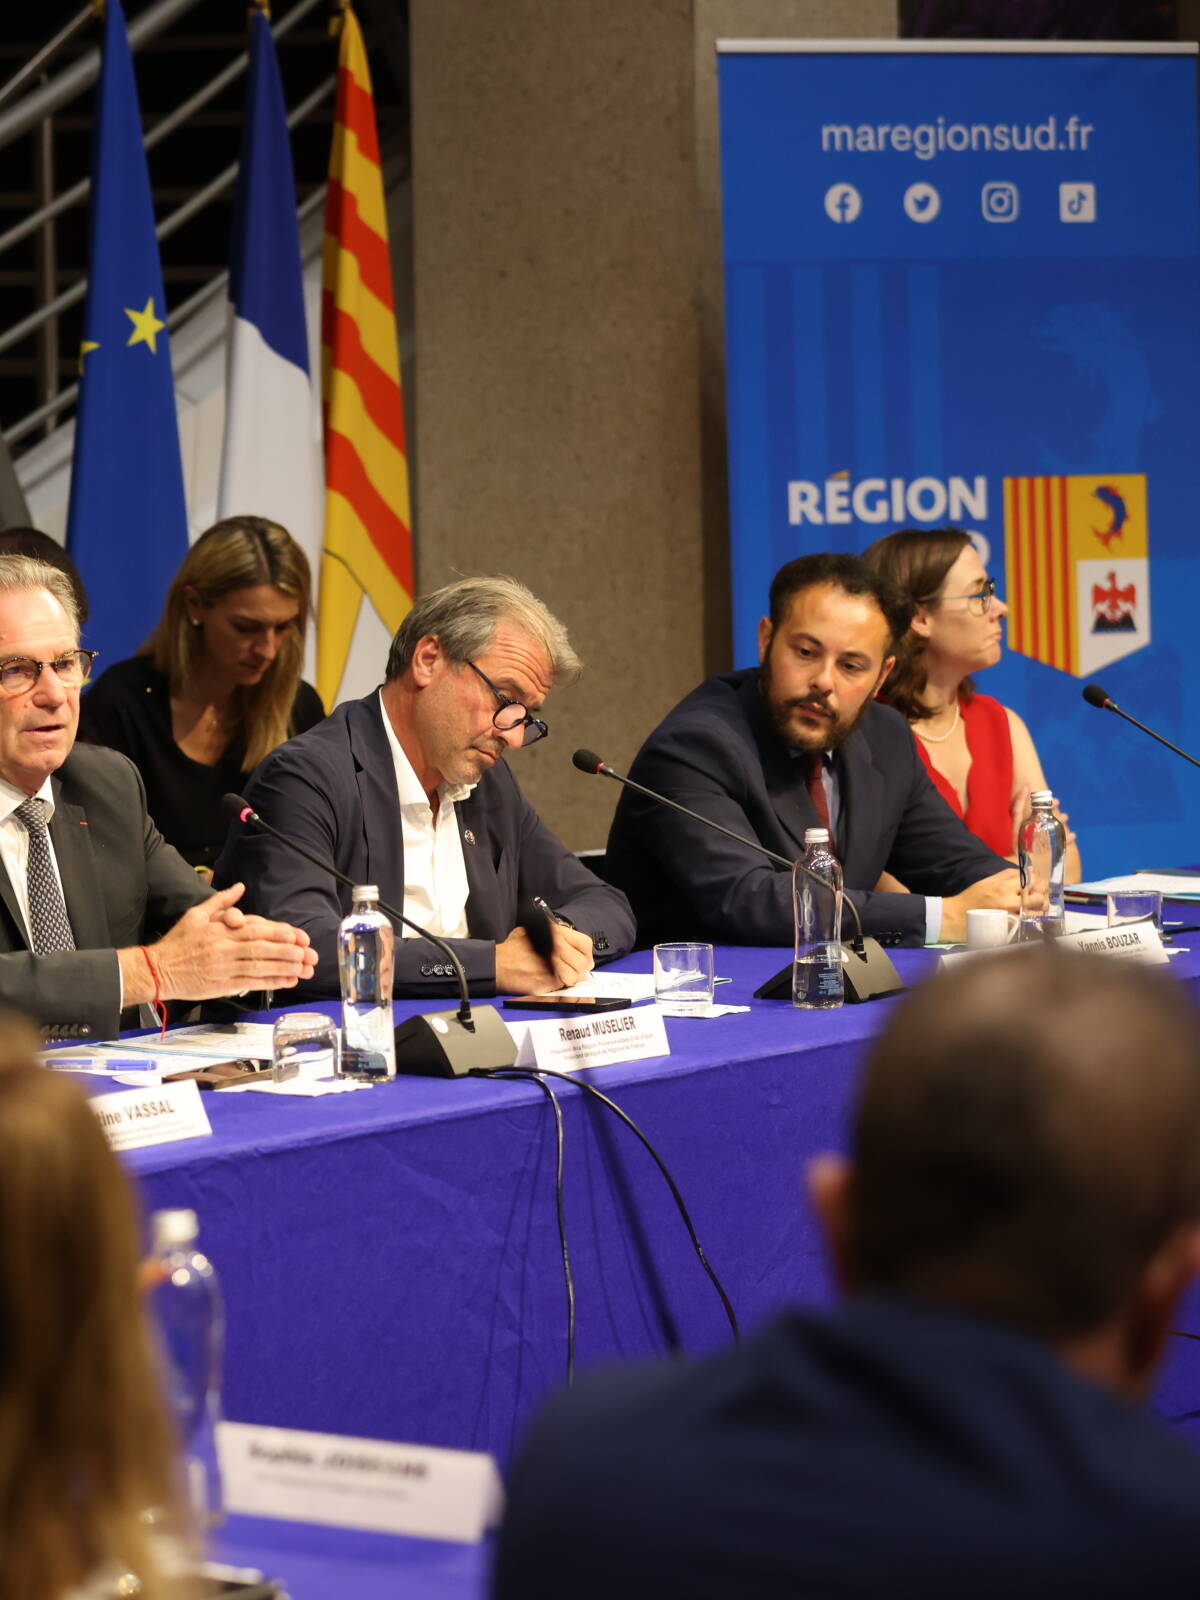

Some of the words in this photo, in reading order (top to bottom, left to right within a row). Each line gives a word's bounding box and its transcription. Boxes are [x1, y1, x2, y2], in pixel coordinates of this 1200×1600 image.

[821, 115, 1094, 160] maregionsud.fr
[788, 470, 989, 525] RÉGION
[1106, 932, 1142, 949] BOUZAR
[558, 1024, 591, 1042] Renaud
[591, 1016, 637, 1036] MUSELIER
[124, 1099, 176, 1121] VASSAL
